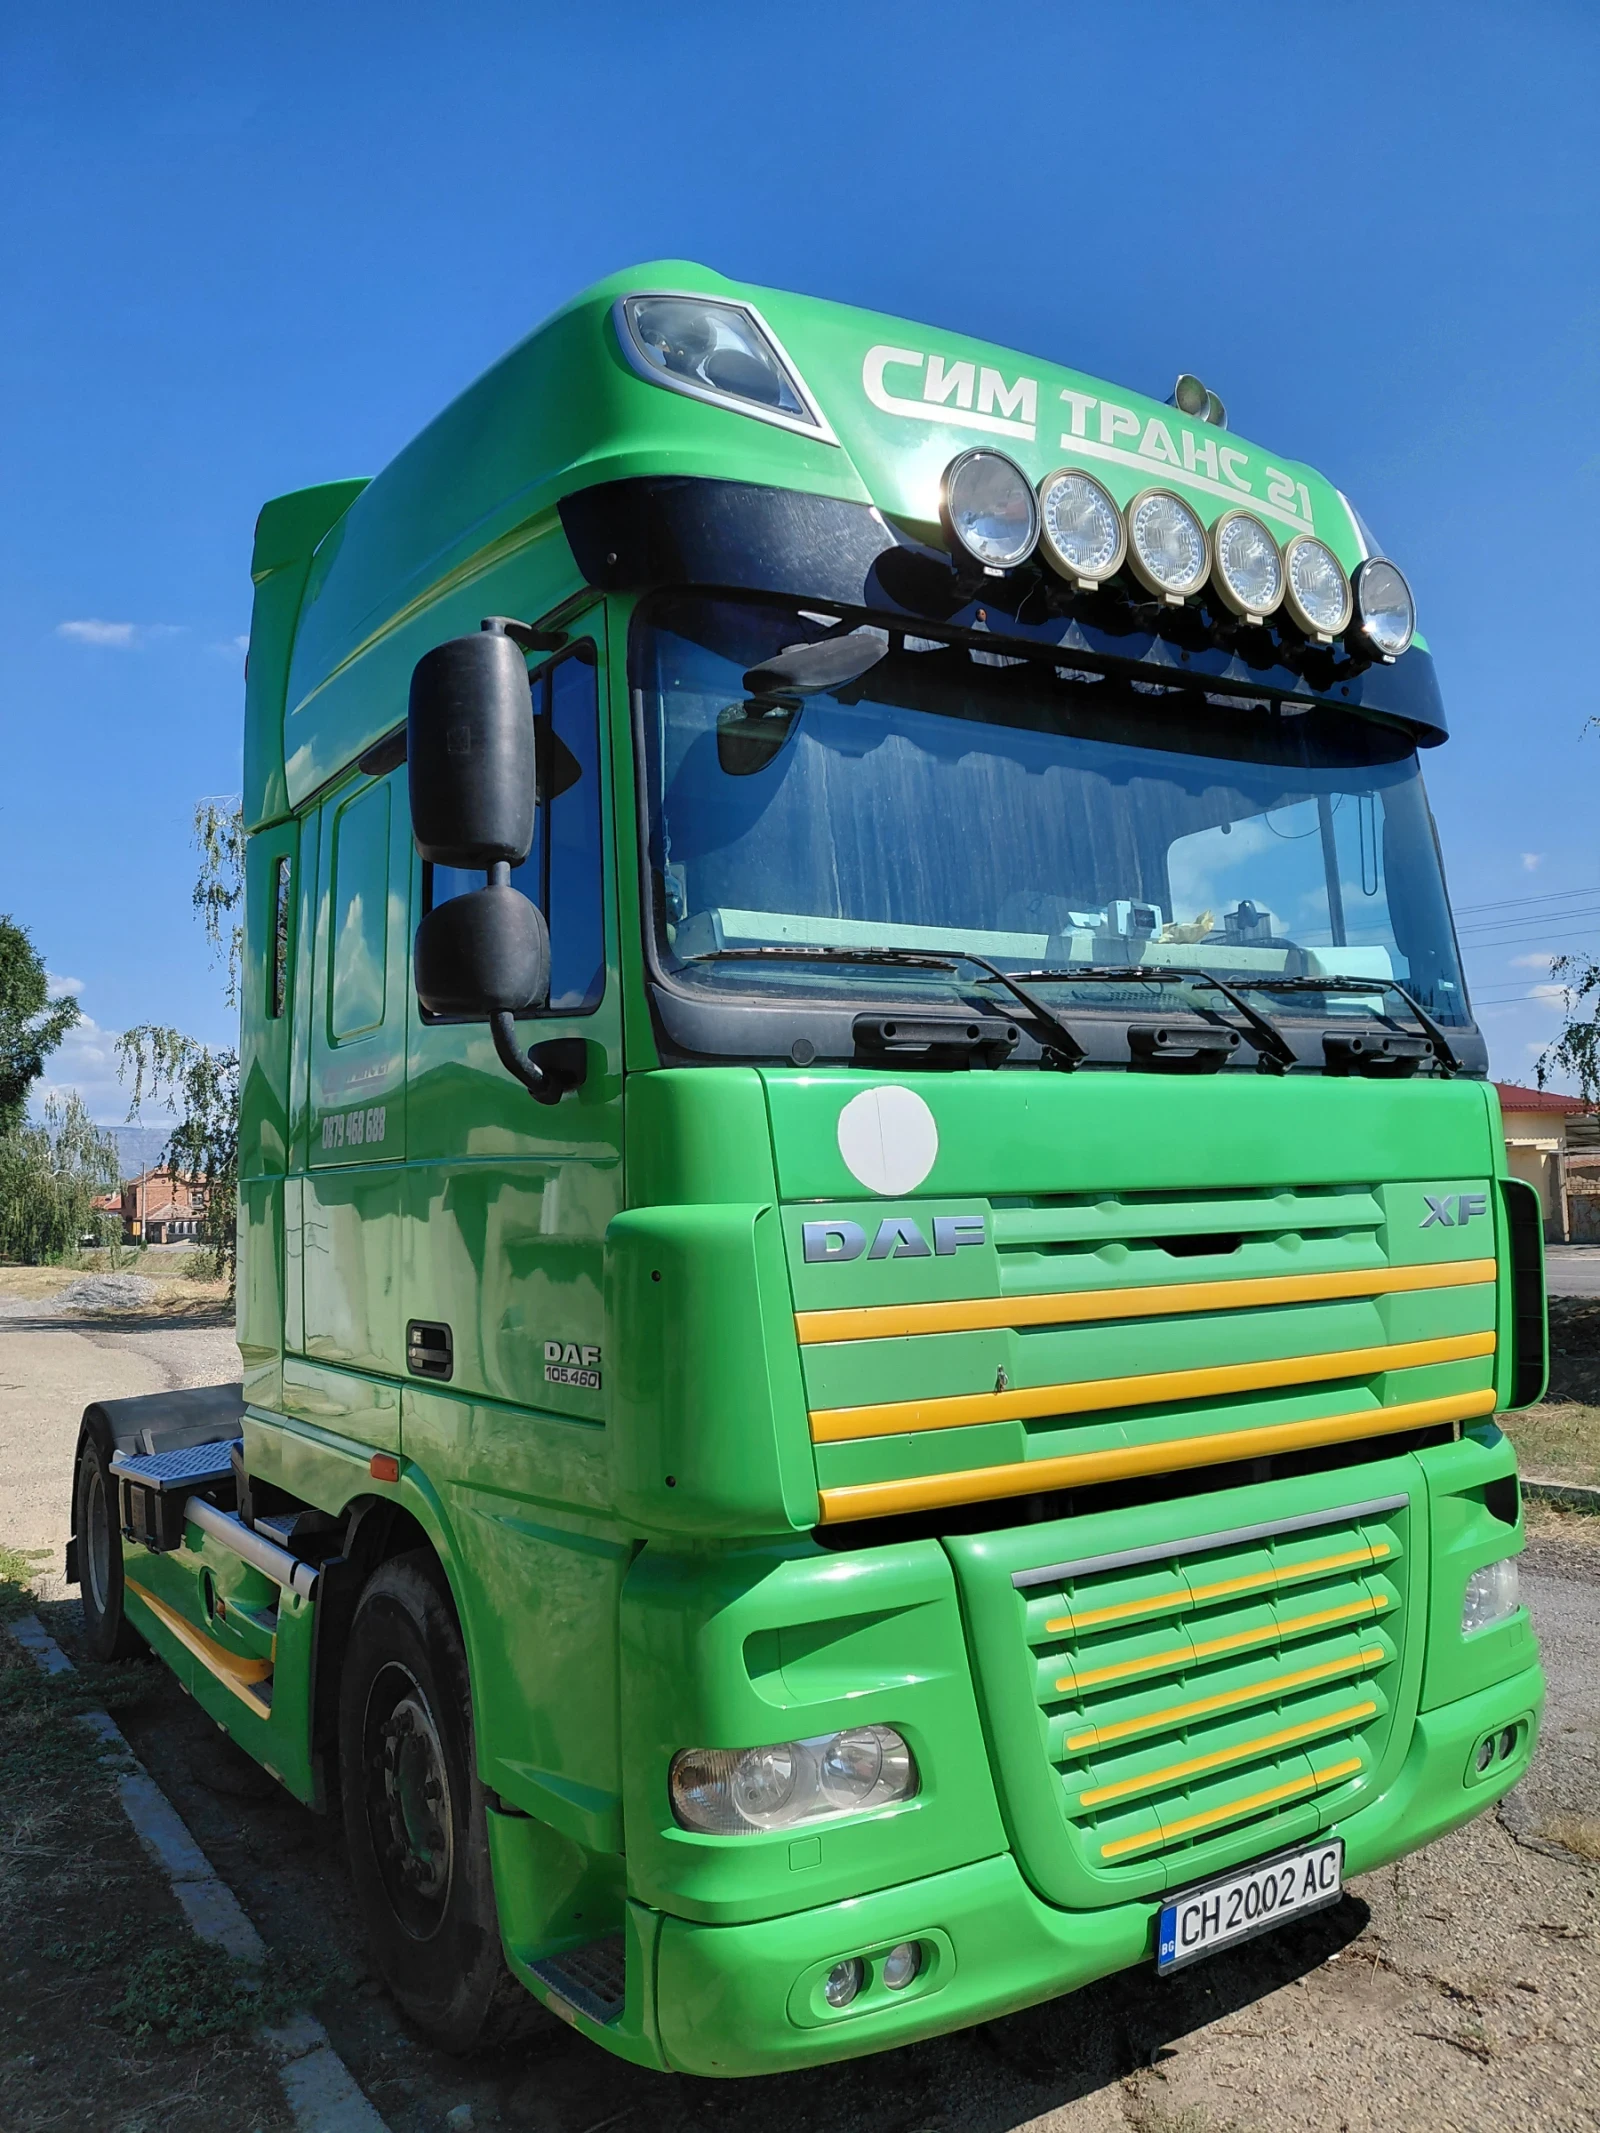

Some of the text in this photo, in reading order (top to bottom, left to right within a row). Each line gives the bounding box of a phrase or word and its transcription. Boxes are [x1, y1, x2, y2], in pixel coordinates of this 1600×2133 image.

[862, 345, 1314, 523] СИМ ТРАНС 21
[322, 1113, 345, 1149] 0879
[1419, 1194, 1487, 1228] XF
[802, 1216, 985, 1263] DAF
[544, 1340, 601, 1366] DAF
[546, 1366, 599, 1387] 105.460
[1225, 1867, 1296, 1930] 2002
[1161, 1940, 1175, 1956] BG
